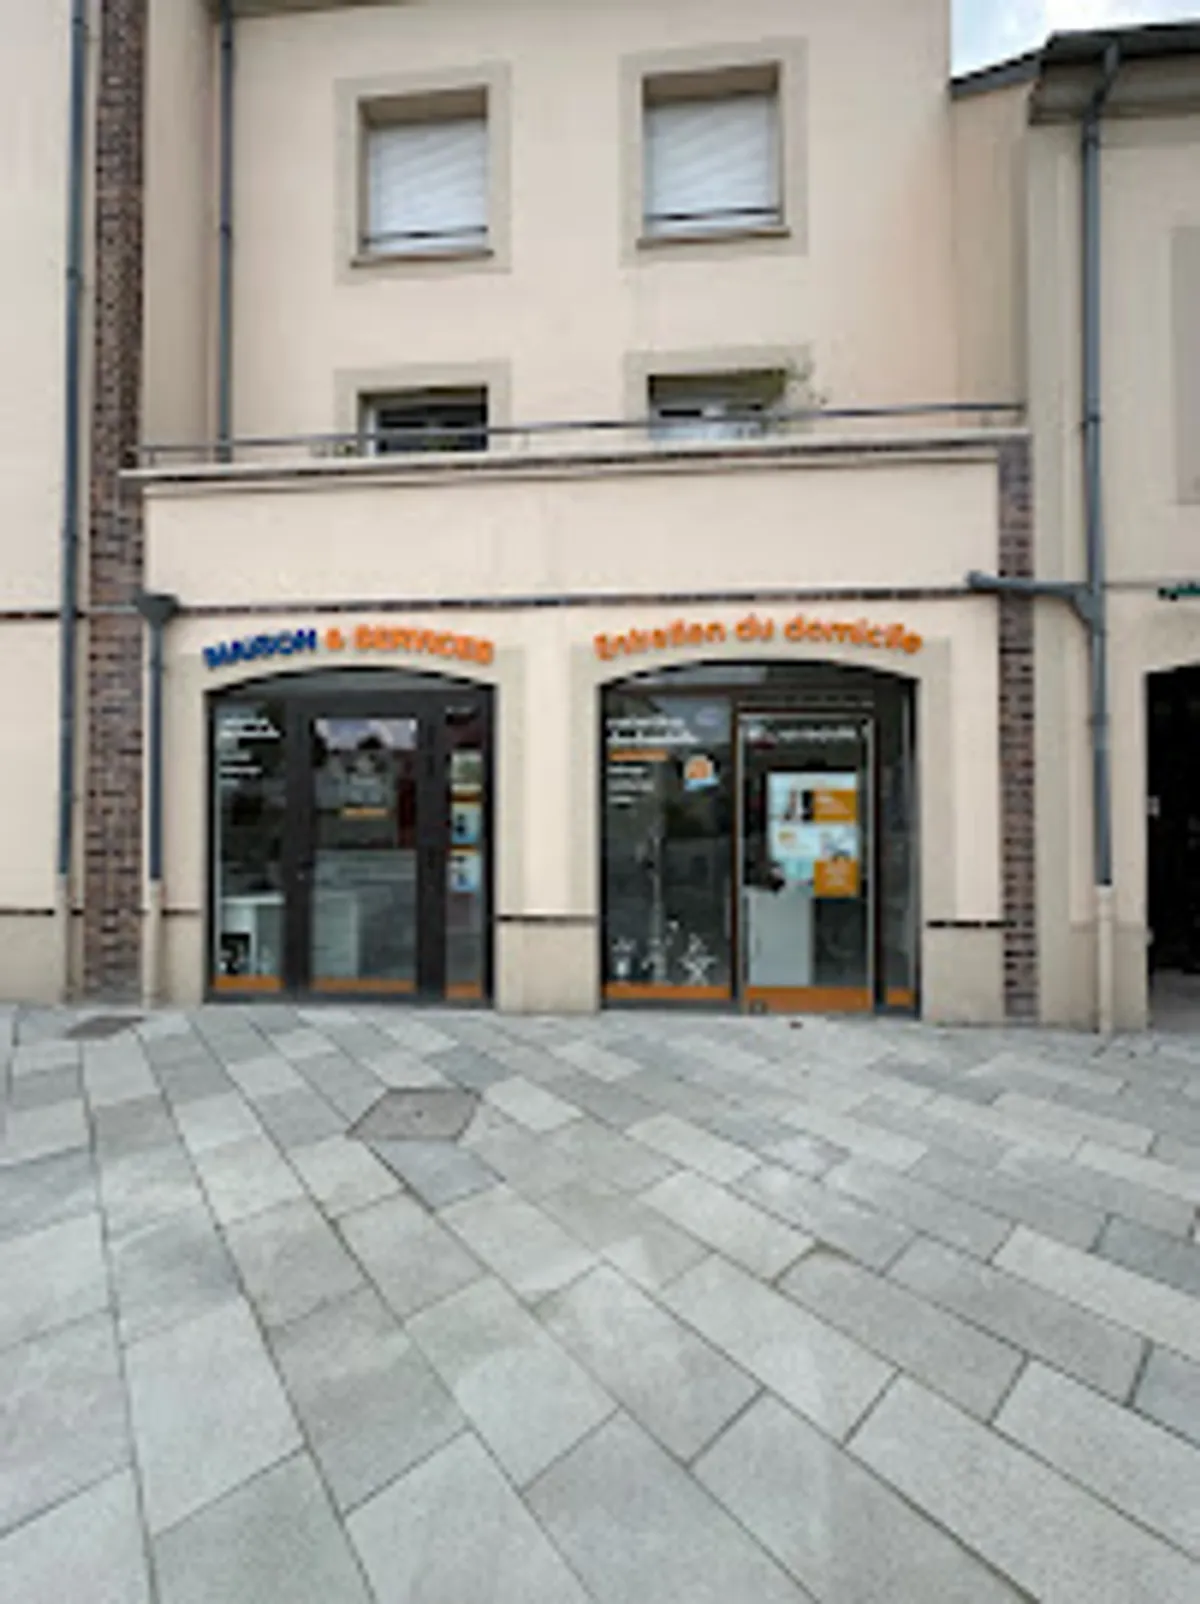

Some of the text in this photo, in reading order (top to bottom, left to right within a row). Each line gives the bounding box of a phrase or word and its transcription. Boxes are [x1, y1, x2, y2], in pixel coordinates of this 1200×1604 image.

[203, 623, 494, 669] MAISON & SERVICES
[594, 611, 922, 661] Entretien du domicile
